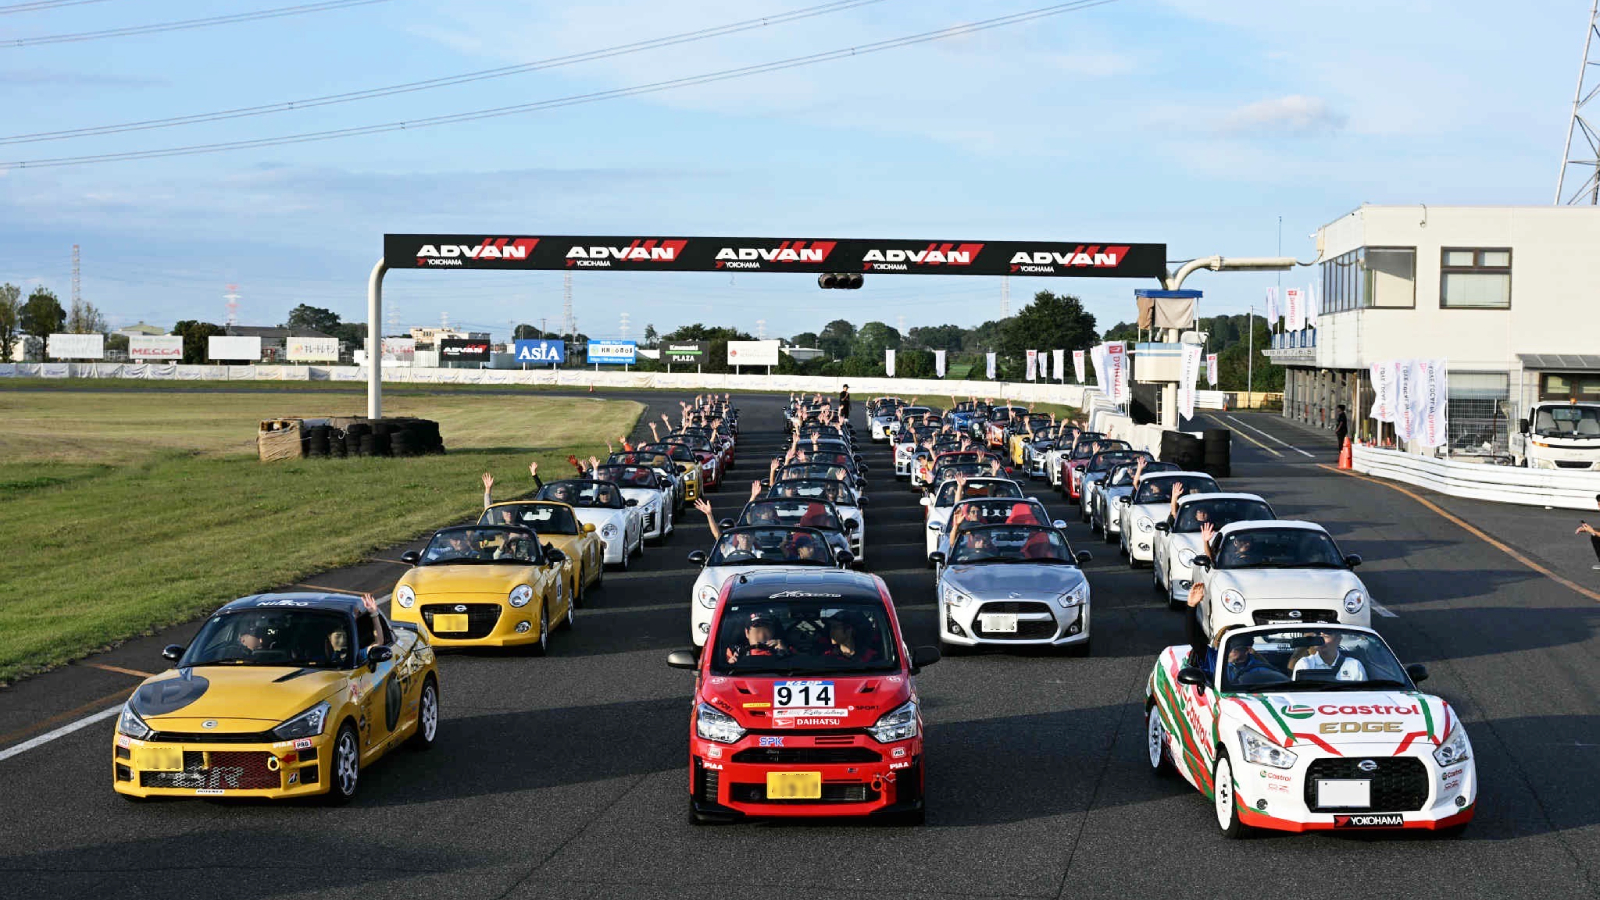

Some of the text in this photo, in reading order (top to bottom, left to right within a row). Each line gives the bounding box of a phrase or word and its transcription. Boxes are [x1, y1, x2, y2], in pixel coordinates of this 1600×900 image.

[416, 244, 526, 258] ADVAN
[565, 246, 674, 260] ADVAN
[714, 248, 823, 260] ADVAN
[862, 249, 970, 263] ADVAN
[1009, 252, 1117, 265] ADVAN
[518, 342, 560, 361] ASIA
[777, 686, 831, 706] 914
[1318, 704, 1420, 715] Castrol
[796, 718, 840, 726] DAIHATSU
[1319, 721, 1403, 734] EDGE
[759, 736, 784, 747] SPK
[1351, 815, 1403, 826] YOKOHAMA
